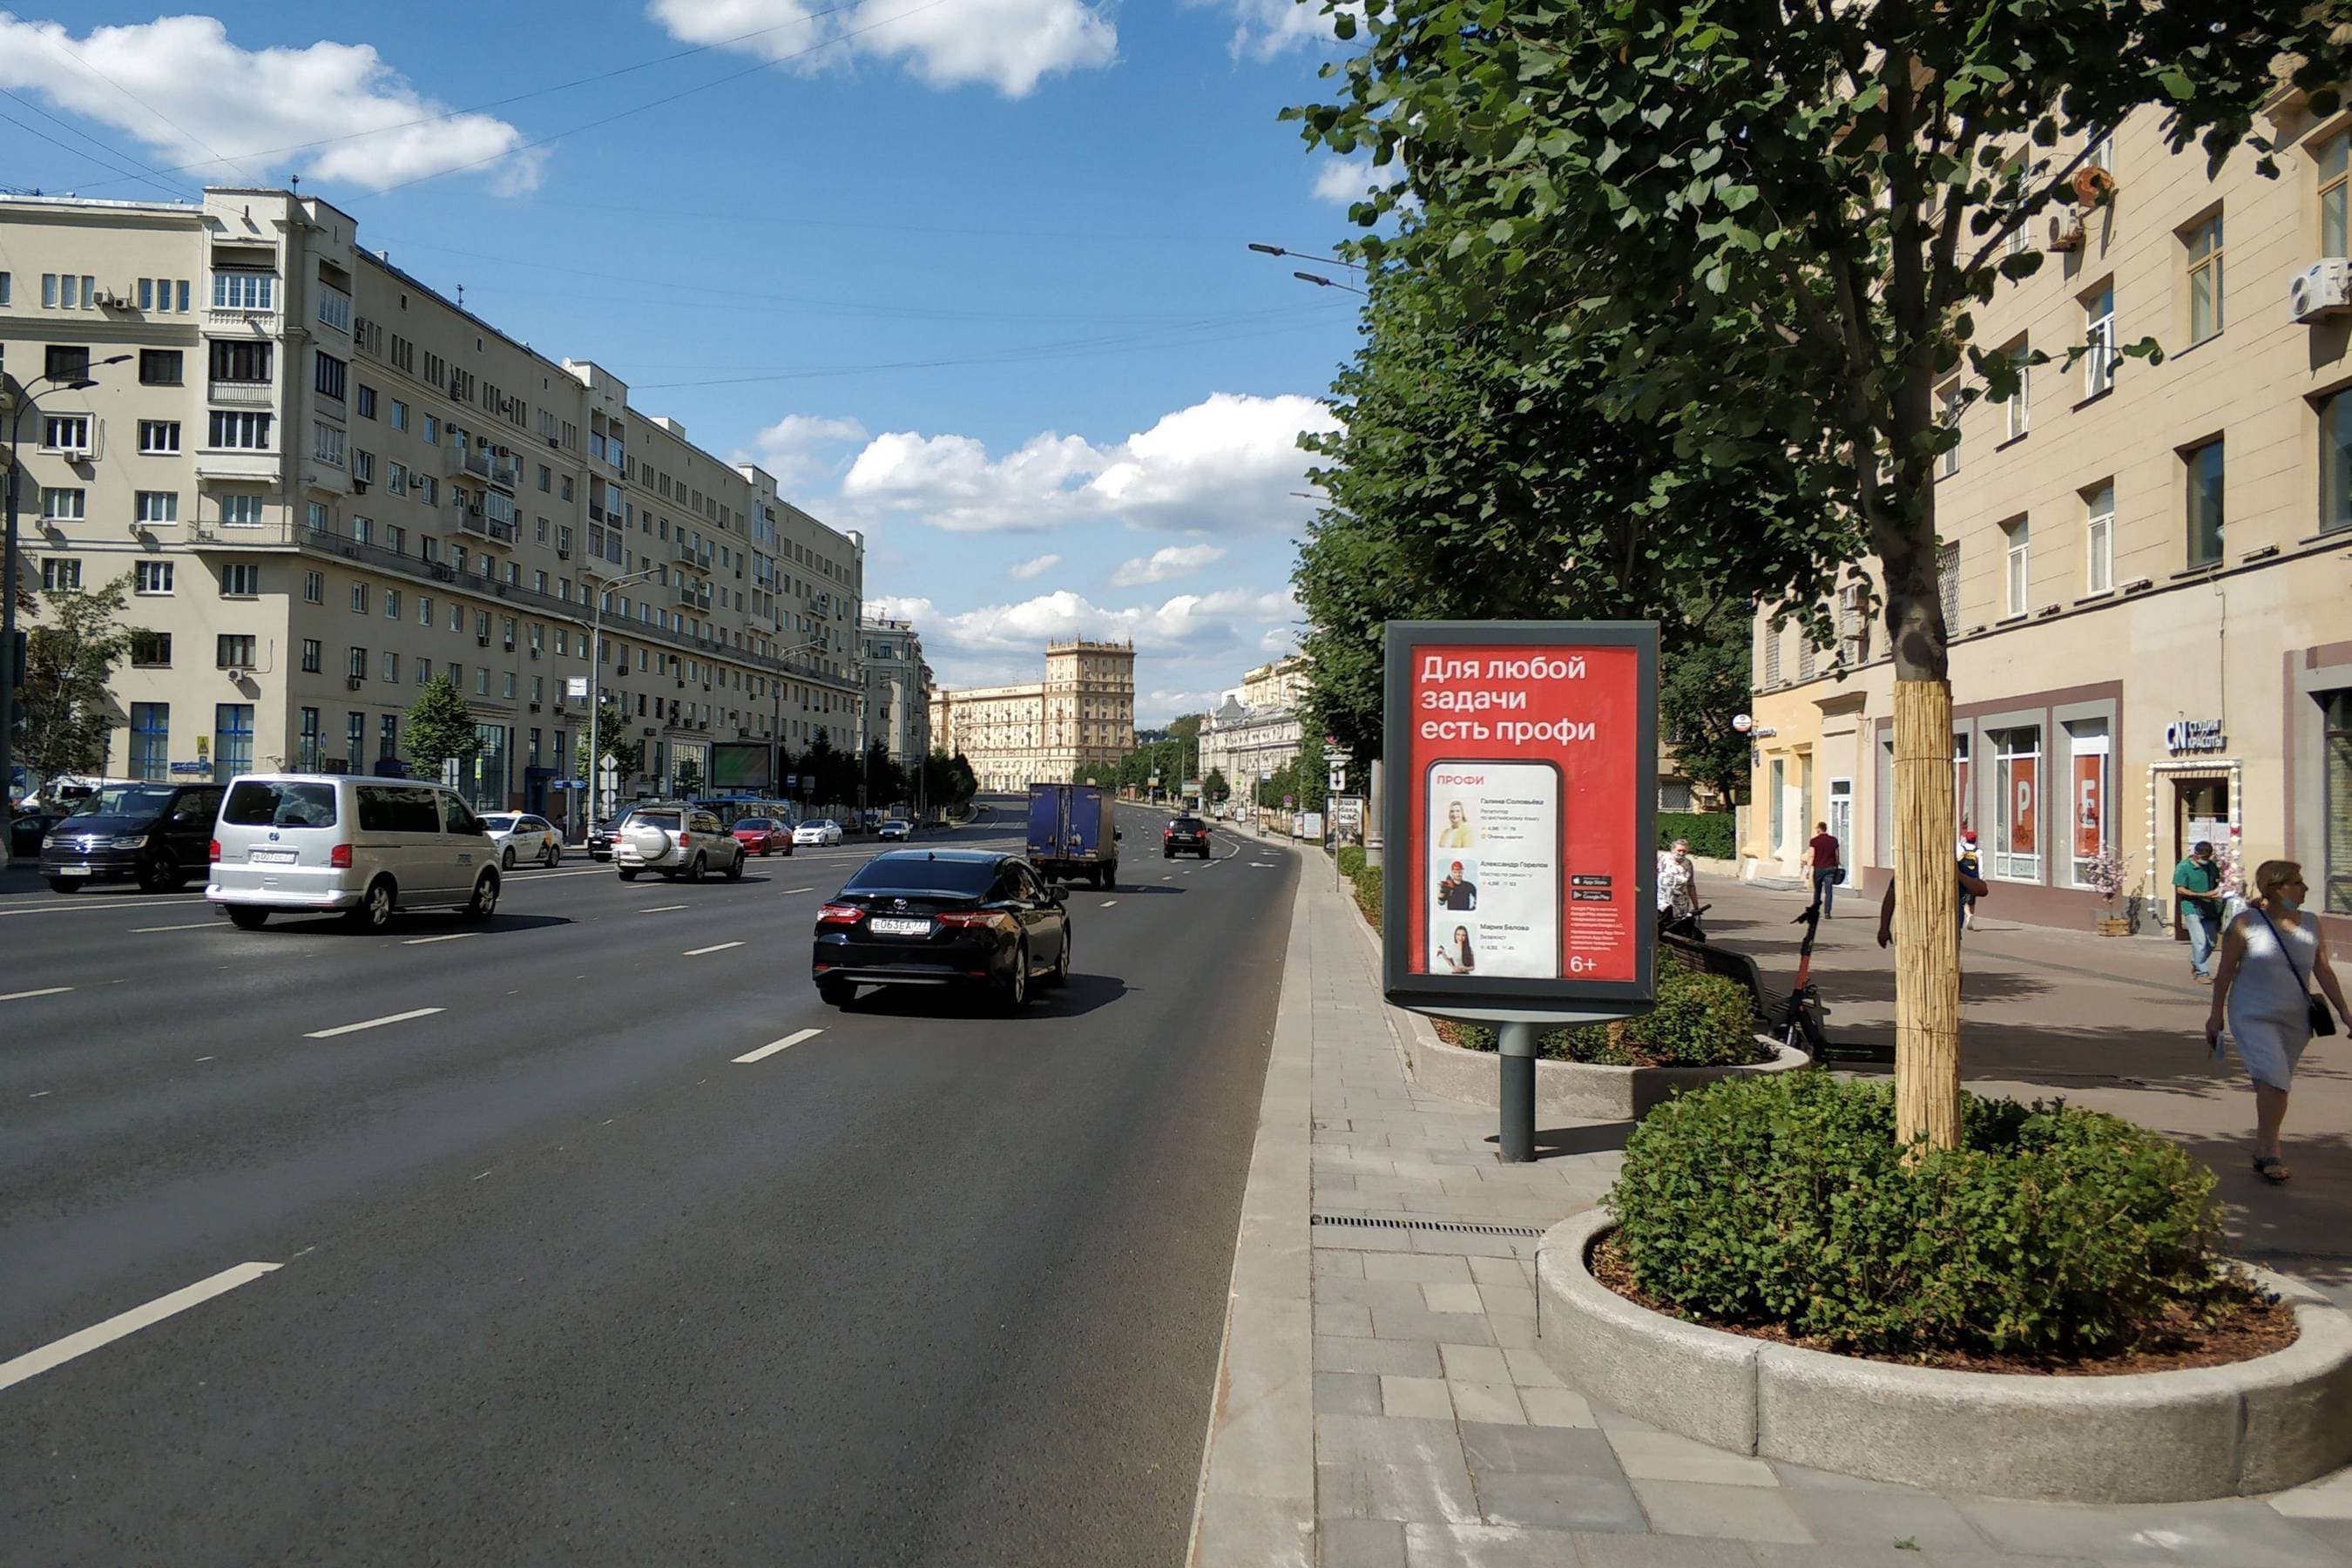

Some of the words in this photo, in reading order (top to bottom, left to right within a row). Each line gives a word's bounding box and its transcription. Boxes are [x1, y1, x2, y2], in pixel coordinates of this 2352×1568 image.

[1421, 656, 1480, 684] Для
[1485, 656, 1585, 679] любой
[1421, 690, 1527, 713] задачи
[1421, 720, 1490, 740] есть
[1496, 718, 1596, 747] профи
[1436, 774, 1484, 785] ПРОФИ
[1570, 956, 1597, 972] 6+
